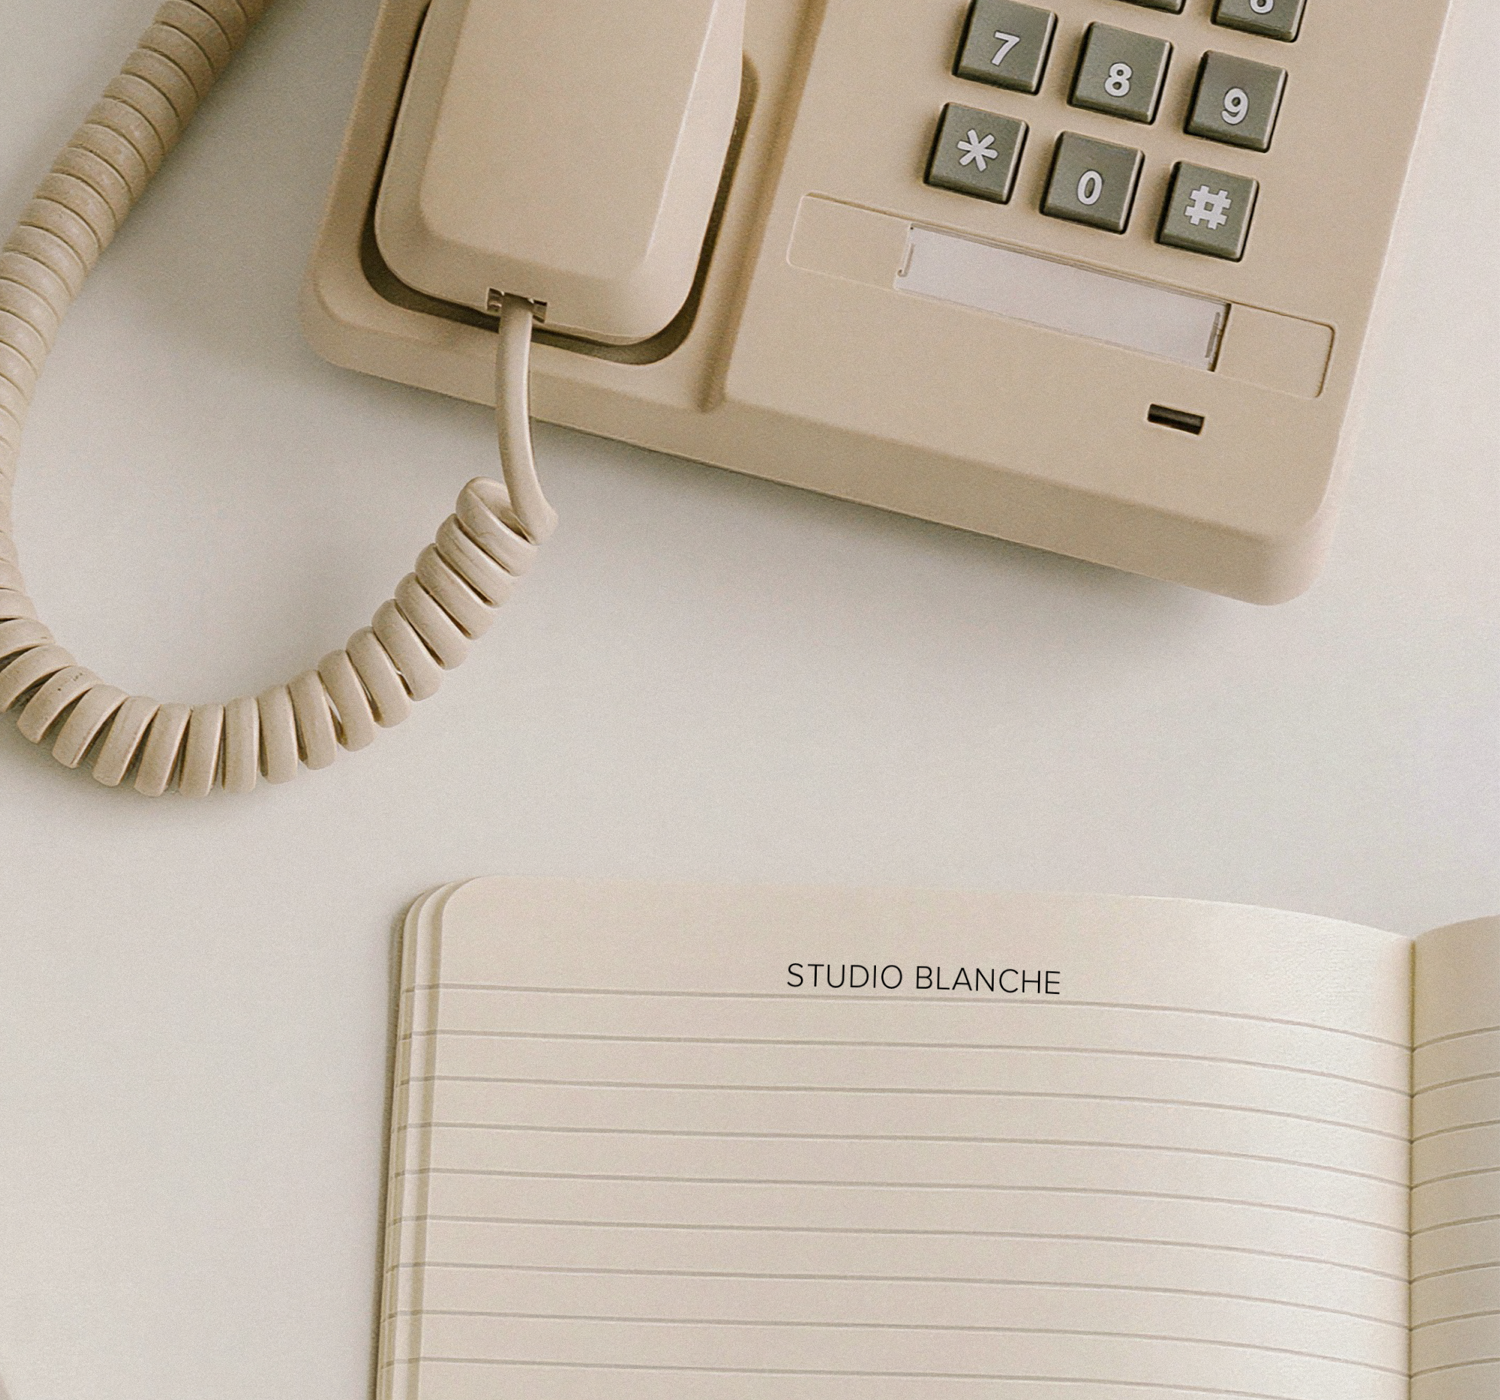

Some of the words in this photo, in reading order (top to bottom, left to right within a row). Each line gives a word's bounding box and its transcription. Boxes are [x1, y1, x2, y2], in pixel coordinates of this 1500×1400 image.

[990, 30, 1021, 67] 7
[1103, 62, 1133, 98] 8
[1220, 87, 1249, 125] 9
[1076, 169, 1103, 206] 0
[786, 962, 903, 990] STUDIO
[915, 965, 1061, 995] BLANCHE
